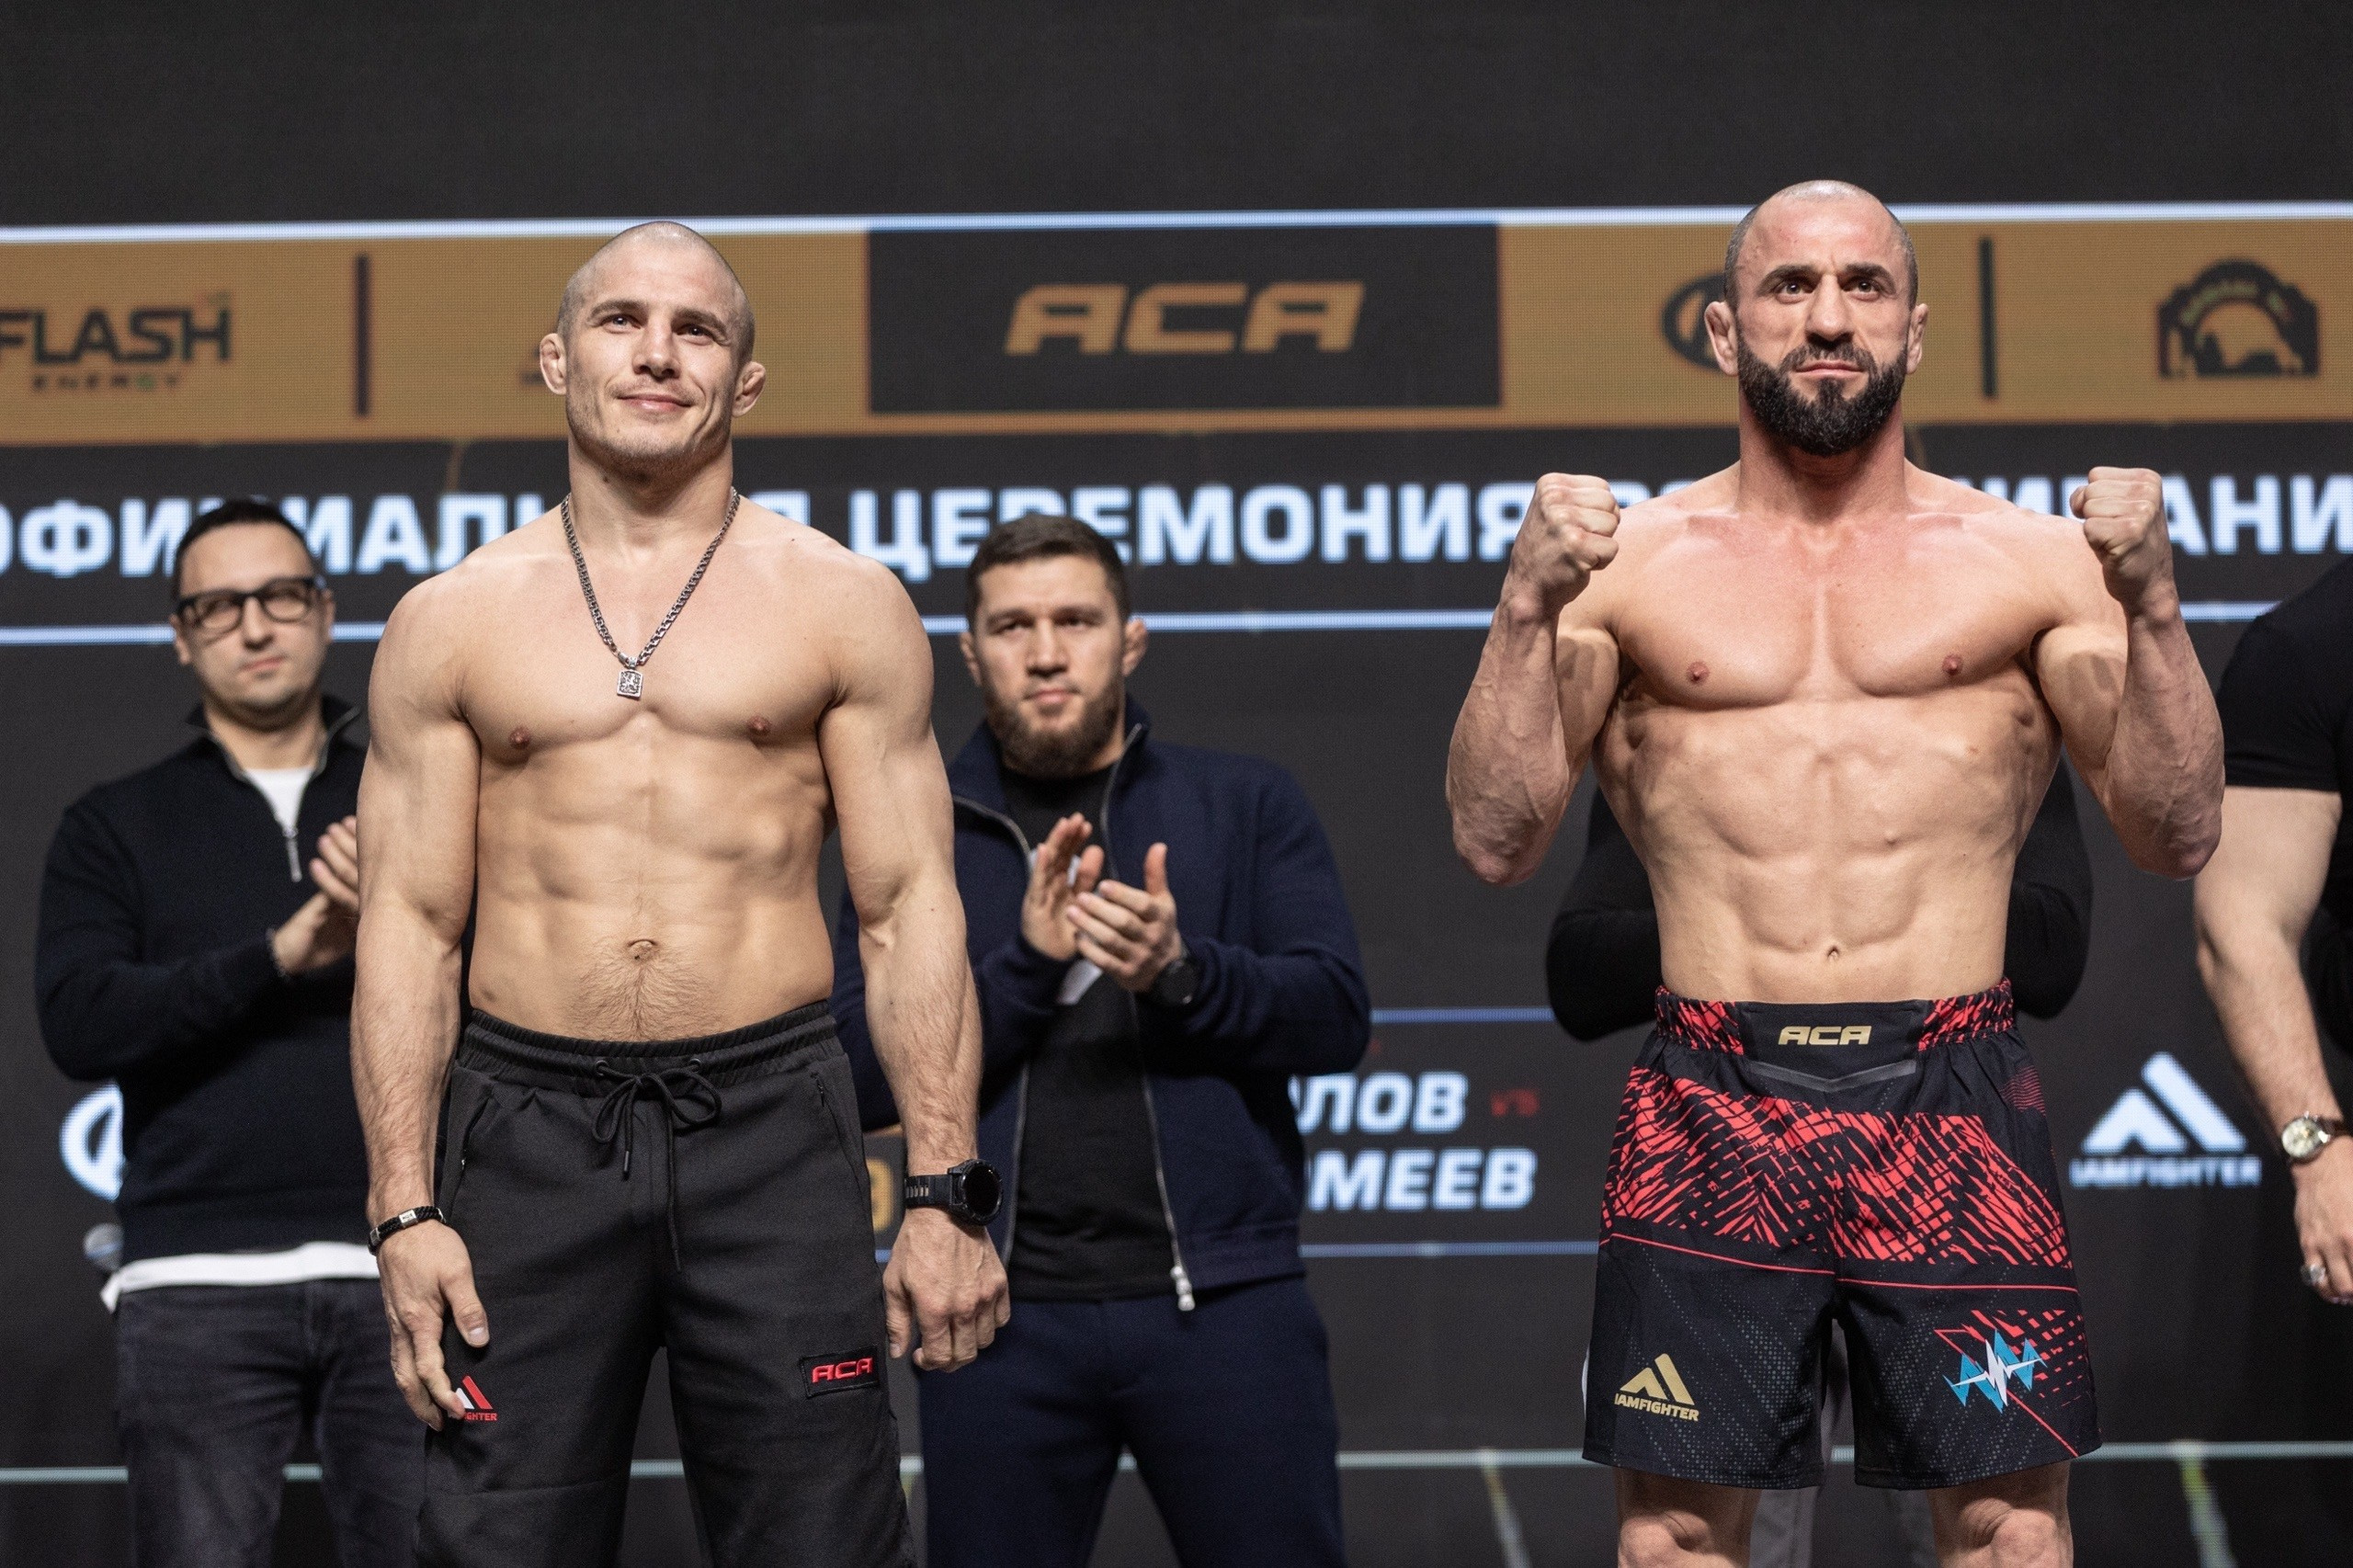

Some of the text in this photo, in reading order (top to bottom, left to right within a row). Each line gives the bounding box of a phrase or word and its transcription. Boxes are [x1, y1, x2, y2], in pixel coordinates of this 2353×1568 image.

[0, 307, 232, 365] FLASH
[1005, 281, 1365, 356] ACA
[1778, 1026, 1872, 1045] ACA
[1288, 1071, 1470, 1136] ЛОВ
[1306, 1146, 1538, 1211] МЕЕВ
[812, 1357, 873, 1383] ACA
[1614, 1392, 1699, 1422] IAMFIGHTER
